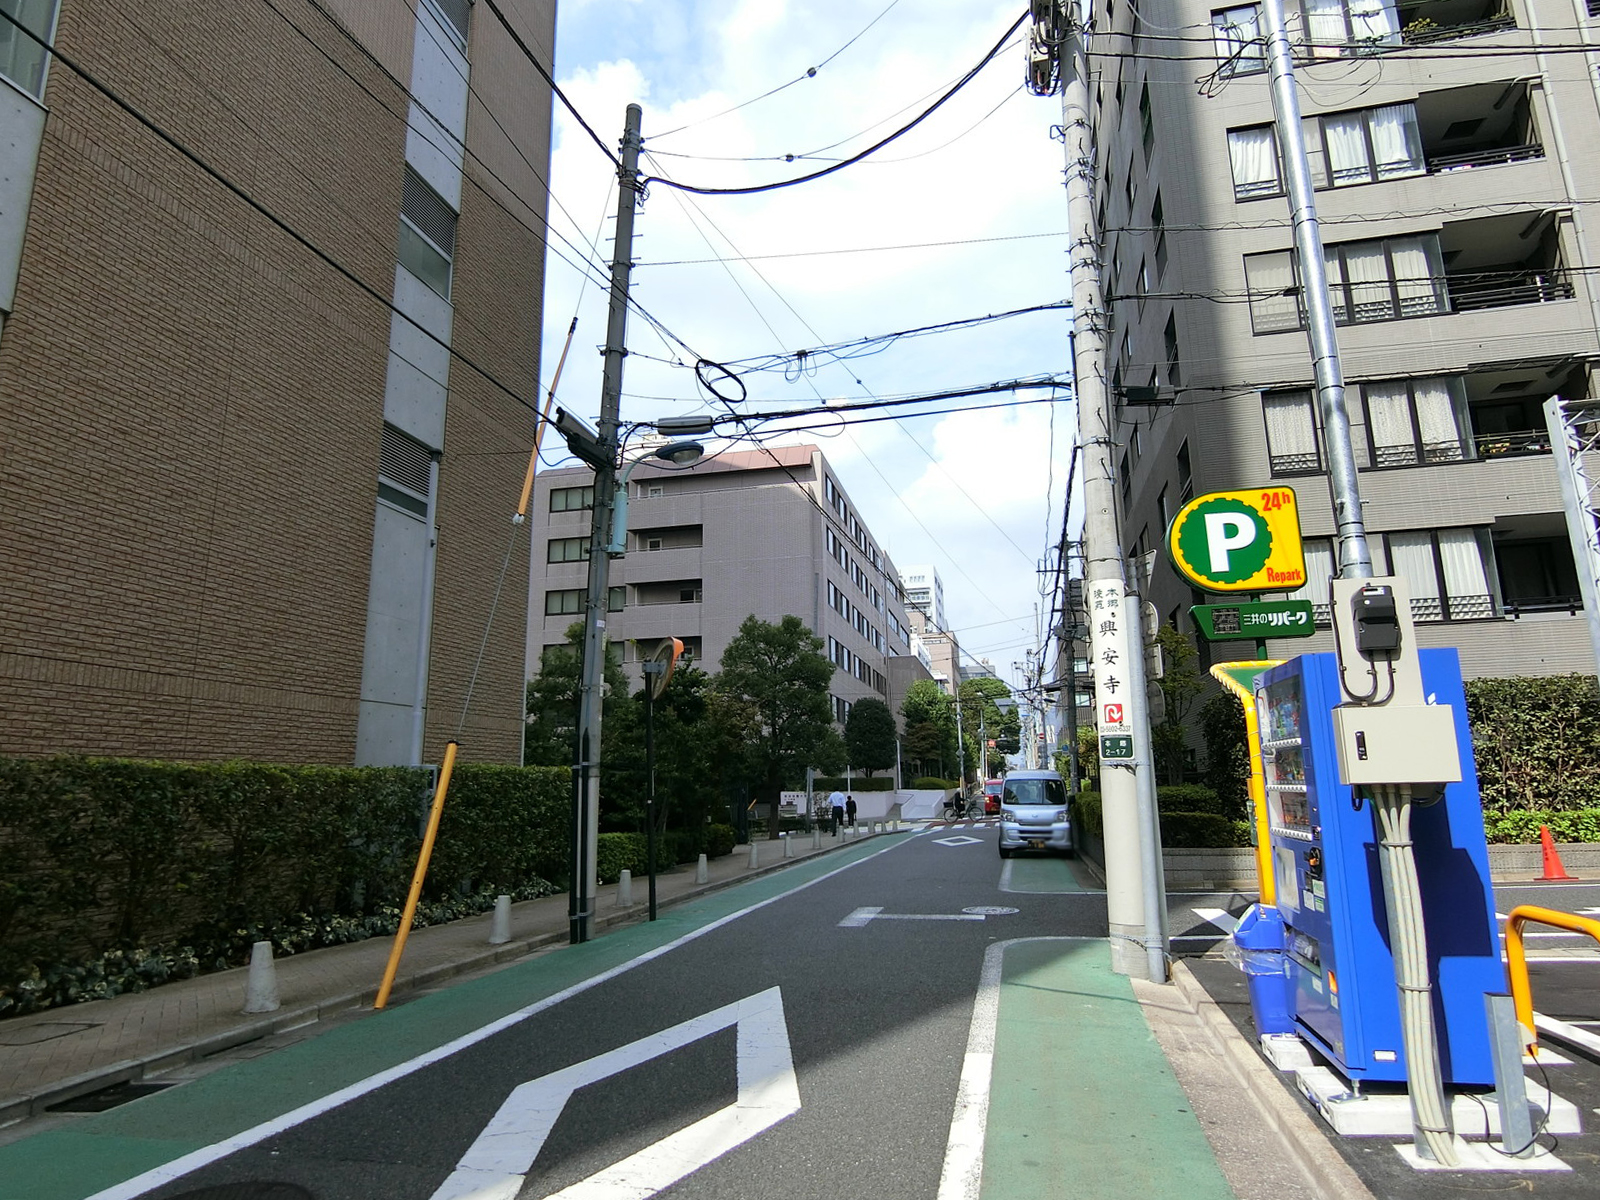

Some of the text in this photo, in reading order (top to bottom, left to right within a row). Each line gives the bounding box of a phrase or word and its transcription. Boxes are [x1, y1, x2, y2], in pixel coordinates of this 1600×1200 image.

[1261, 491, 1291, 512] 24h
[1204, 511, 1257, 574] P
[1266, 567, 1302, 584] Repark
[1243, 610, 1308, 627] 三井のリパーク
[1099, 619, 1121, 695] 興安寺
[1105, 748, 1127, 756] 2-17
